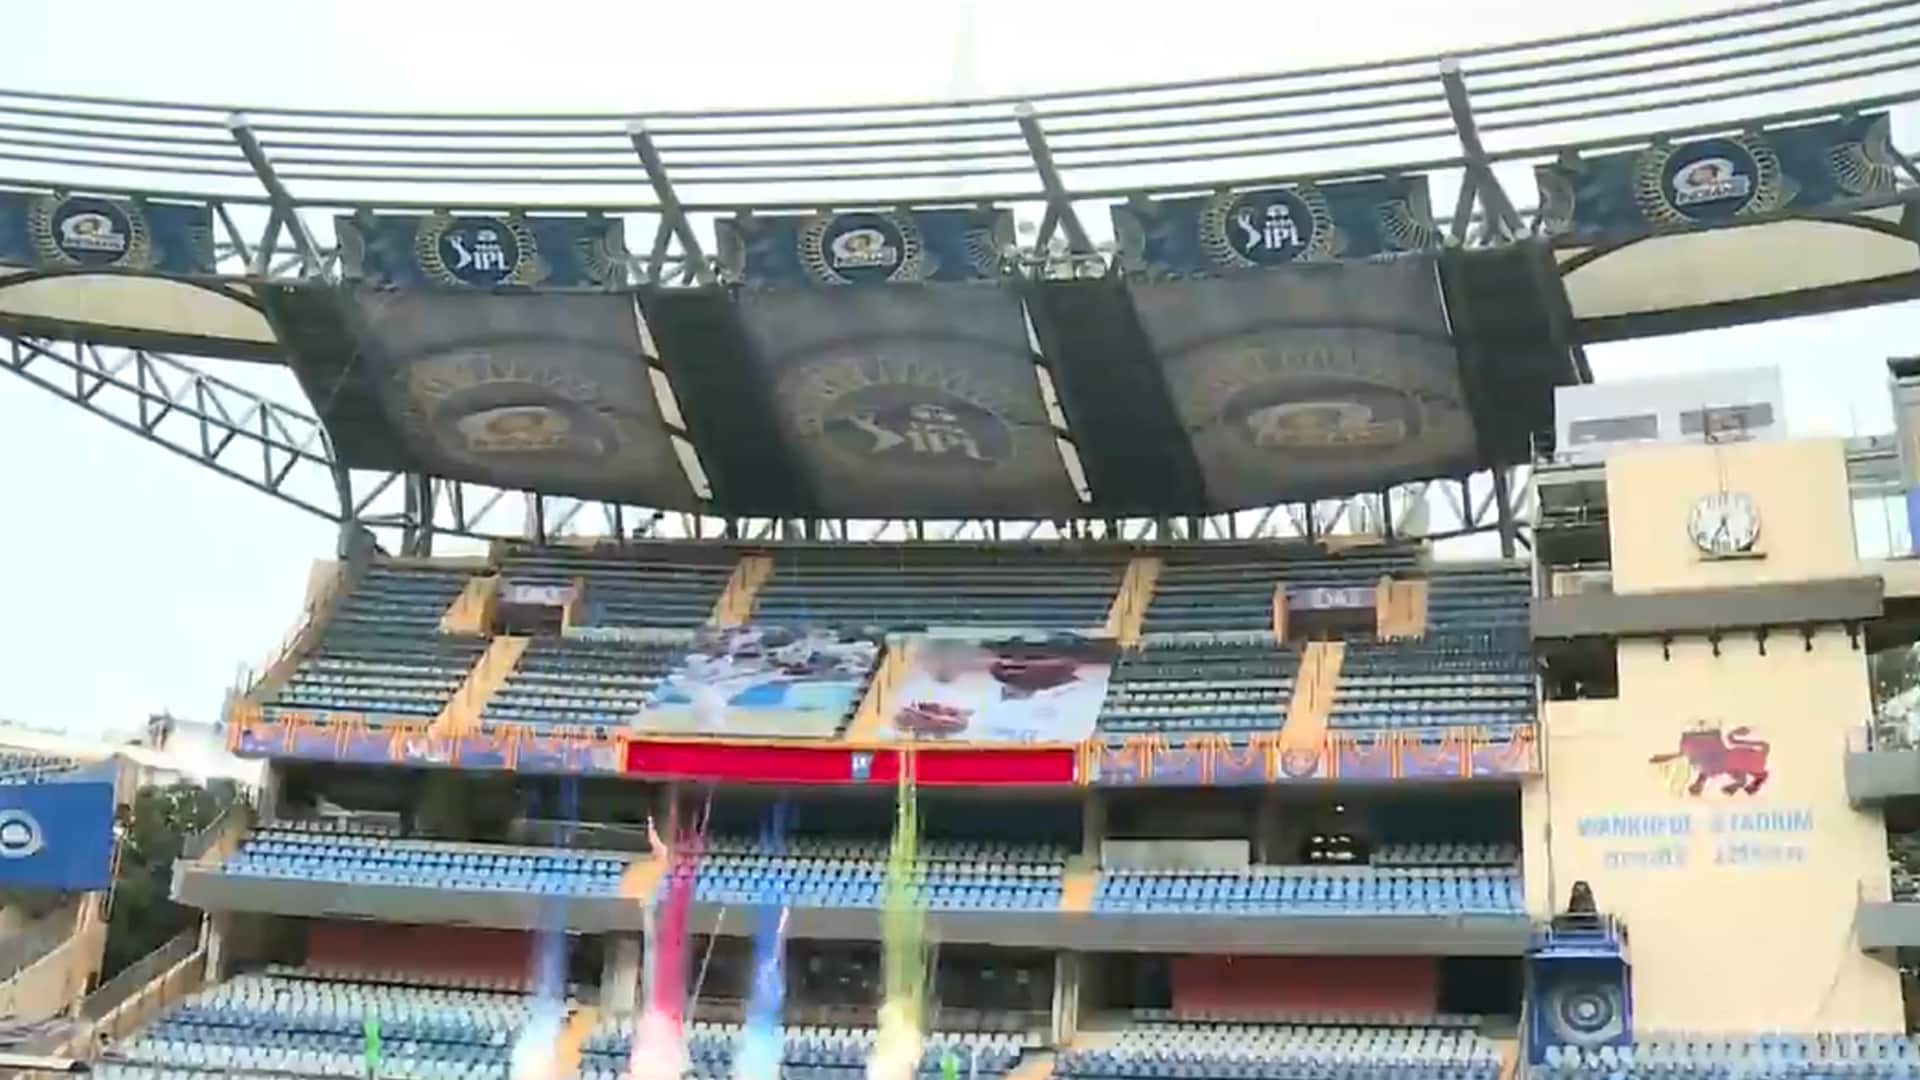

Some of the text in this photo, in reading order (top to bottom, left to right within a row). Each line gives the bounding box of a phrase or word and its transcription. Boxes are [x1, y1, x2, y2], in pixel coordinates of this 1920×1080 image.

[1264, 226, 1304, 249] IPL
[473, 250, 511, 270] IPL
[1710, 808, 1814, 832] TADIUM
